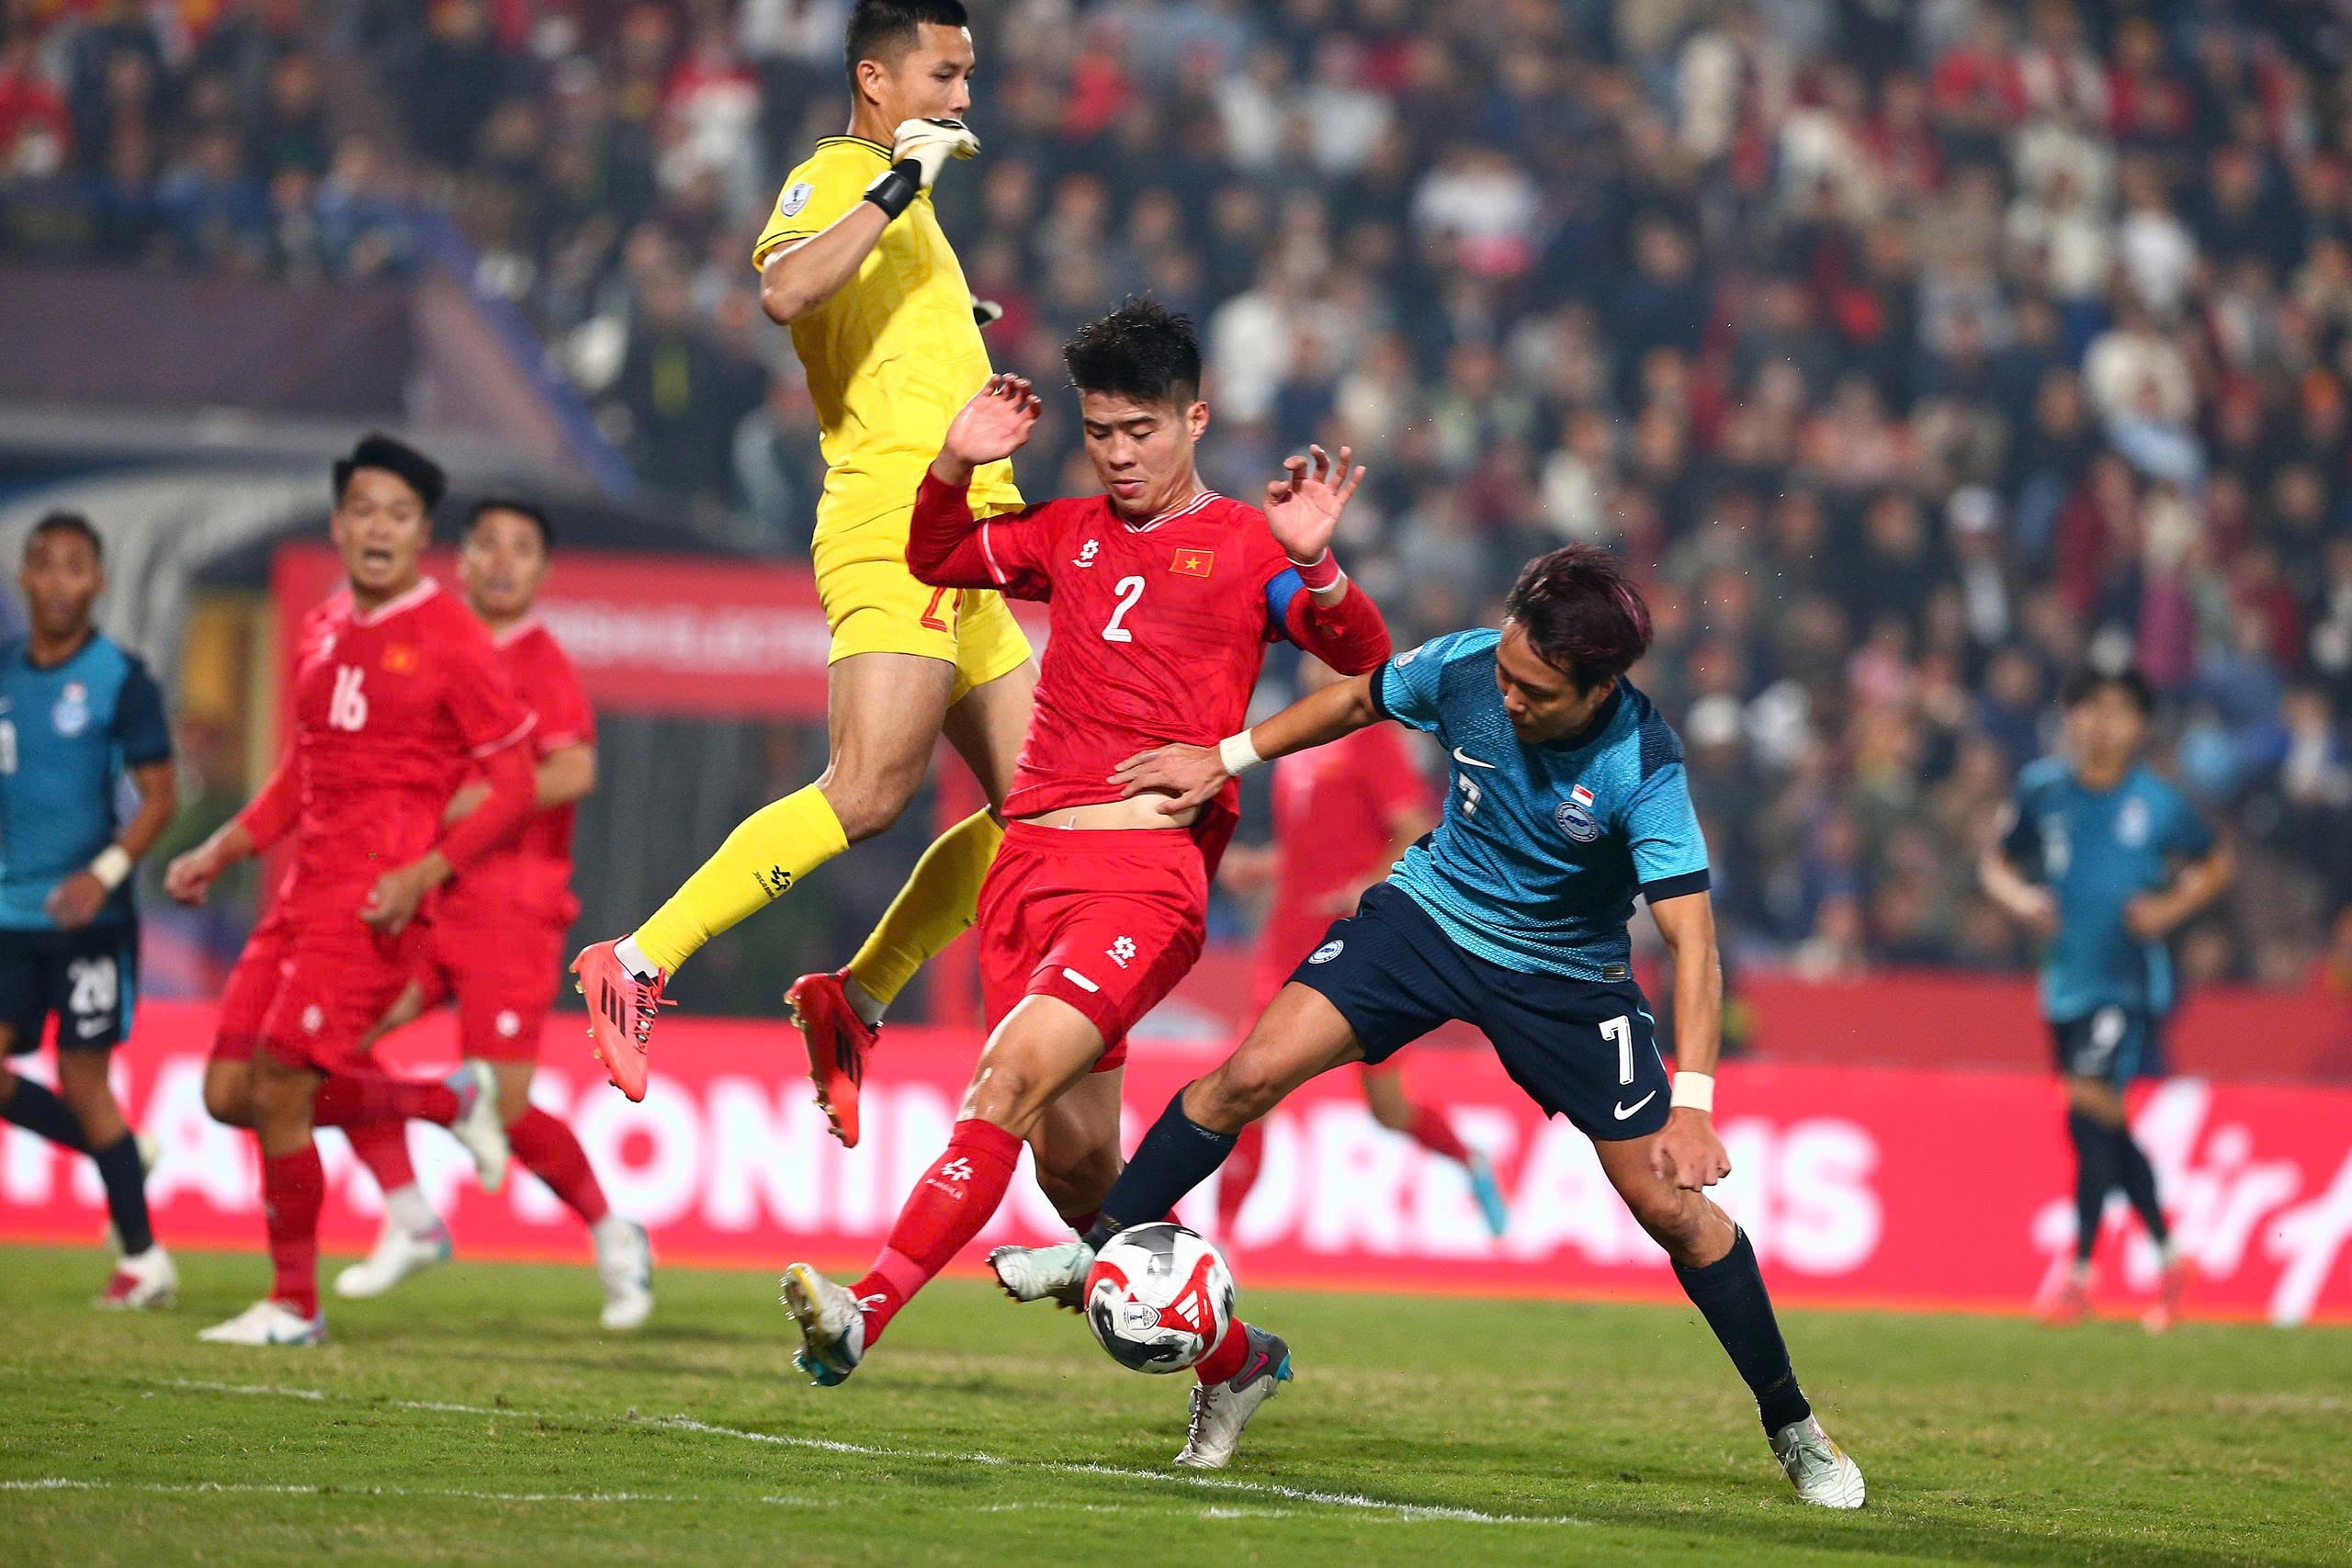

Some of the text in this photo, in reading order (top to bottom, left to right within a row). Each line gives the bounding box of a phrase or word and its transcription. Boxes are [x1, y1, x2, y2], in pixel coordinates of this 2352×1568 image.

[1102, 575, 1146, 643] 2
[329, 664, 368, 732] 16
[1598, 1014, 1634, 1086] 7
